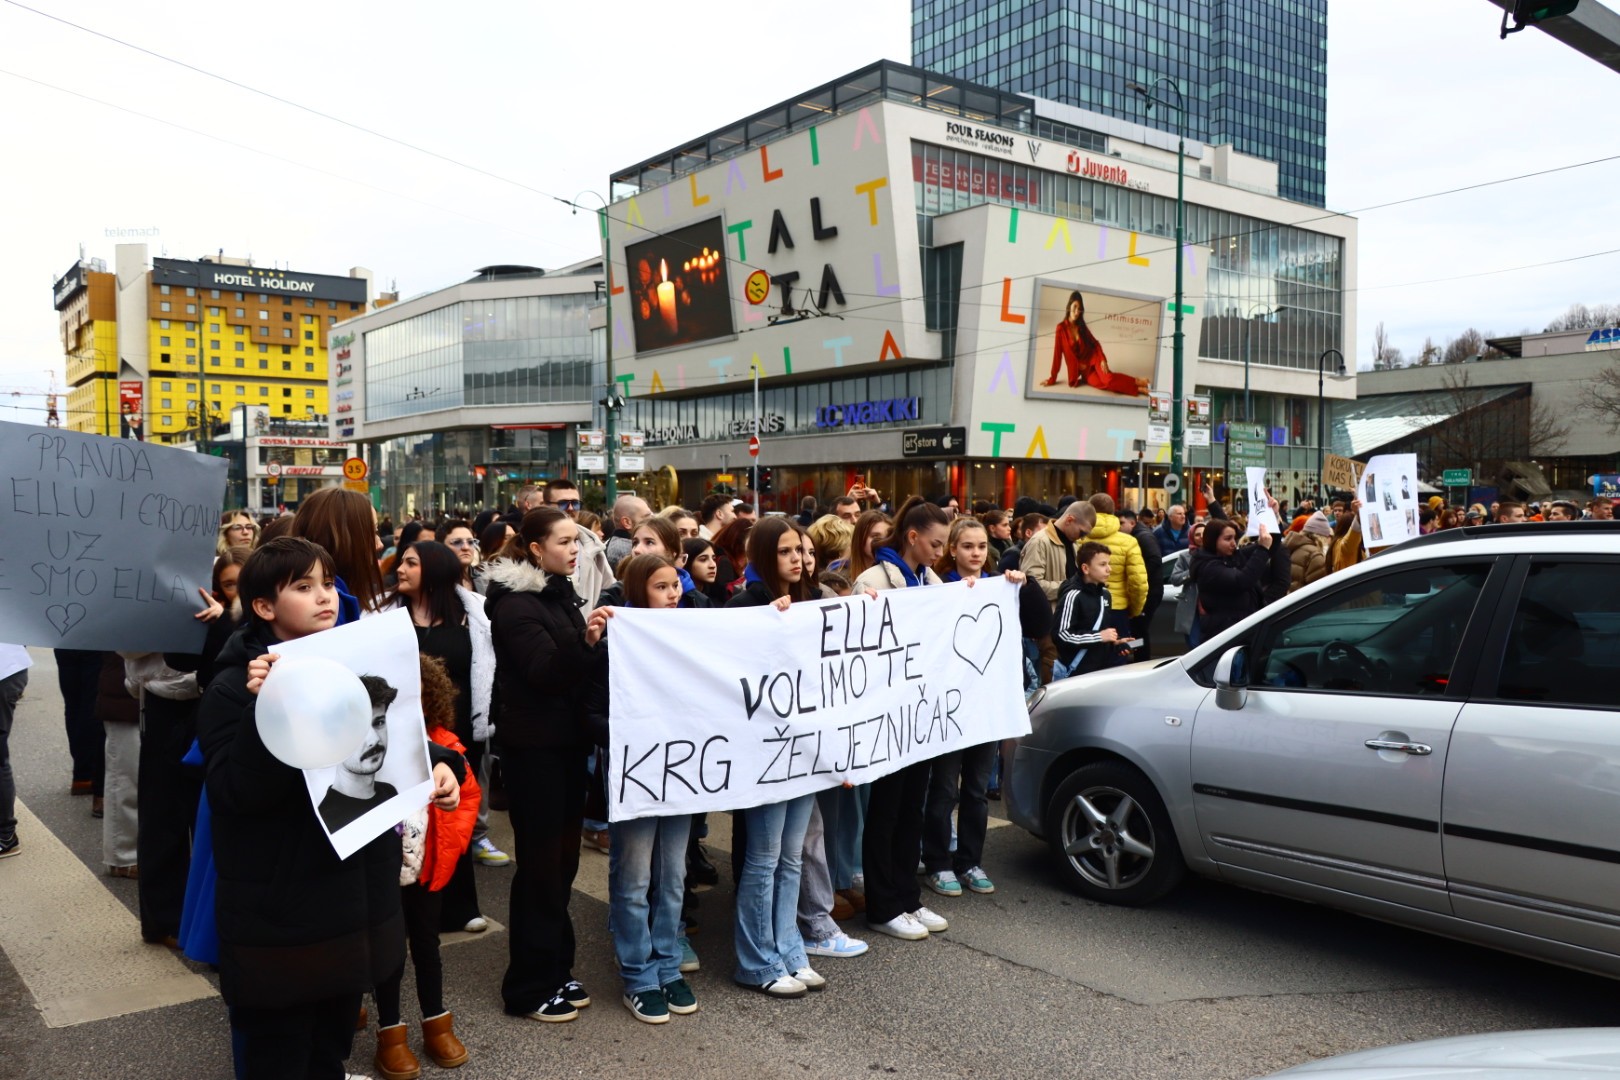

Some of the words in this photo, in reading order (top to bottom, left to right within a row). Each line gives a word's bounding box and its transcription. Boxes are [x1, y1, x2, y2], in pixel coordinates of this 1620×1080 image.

[947, 122, 973, 138] FOUR
[975, 128, 1014, 147] SEASONS
[1083, 157, 1127, 185] Juventa
[104, 226, 160, 238] telemach
[214, 272, 256, 287] HOTEL
[260, 277, 316, 292] HOLIDAY
[723, 416, 780, 435] TEZENIS
[816, 405, 840, 429] LC
[28, 432, 154, 483] PRAVDA
[917, 437, 937, 448] store
[11, 477, 95, 519] ELLU
[119, 491, 125, 520] I
[47, 528, 105, 562] UZ
[30, 562, 98, 597] SMO
[113, 567, 190, 604] ELLA
[820, 597, 899, 658] ELLA
[740, 653, 867, 721] VOLIMO
[877, 642, 924, 688] TE
[619, 734, 732, 804] KRG
[756, 682, 963, 786] ŽELJEZNIČAR
